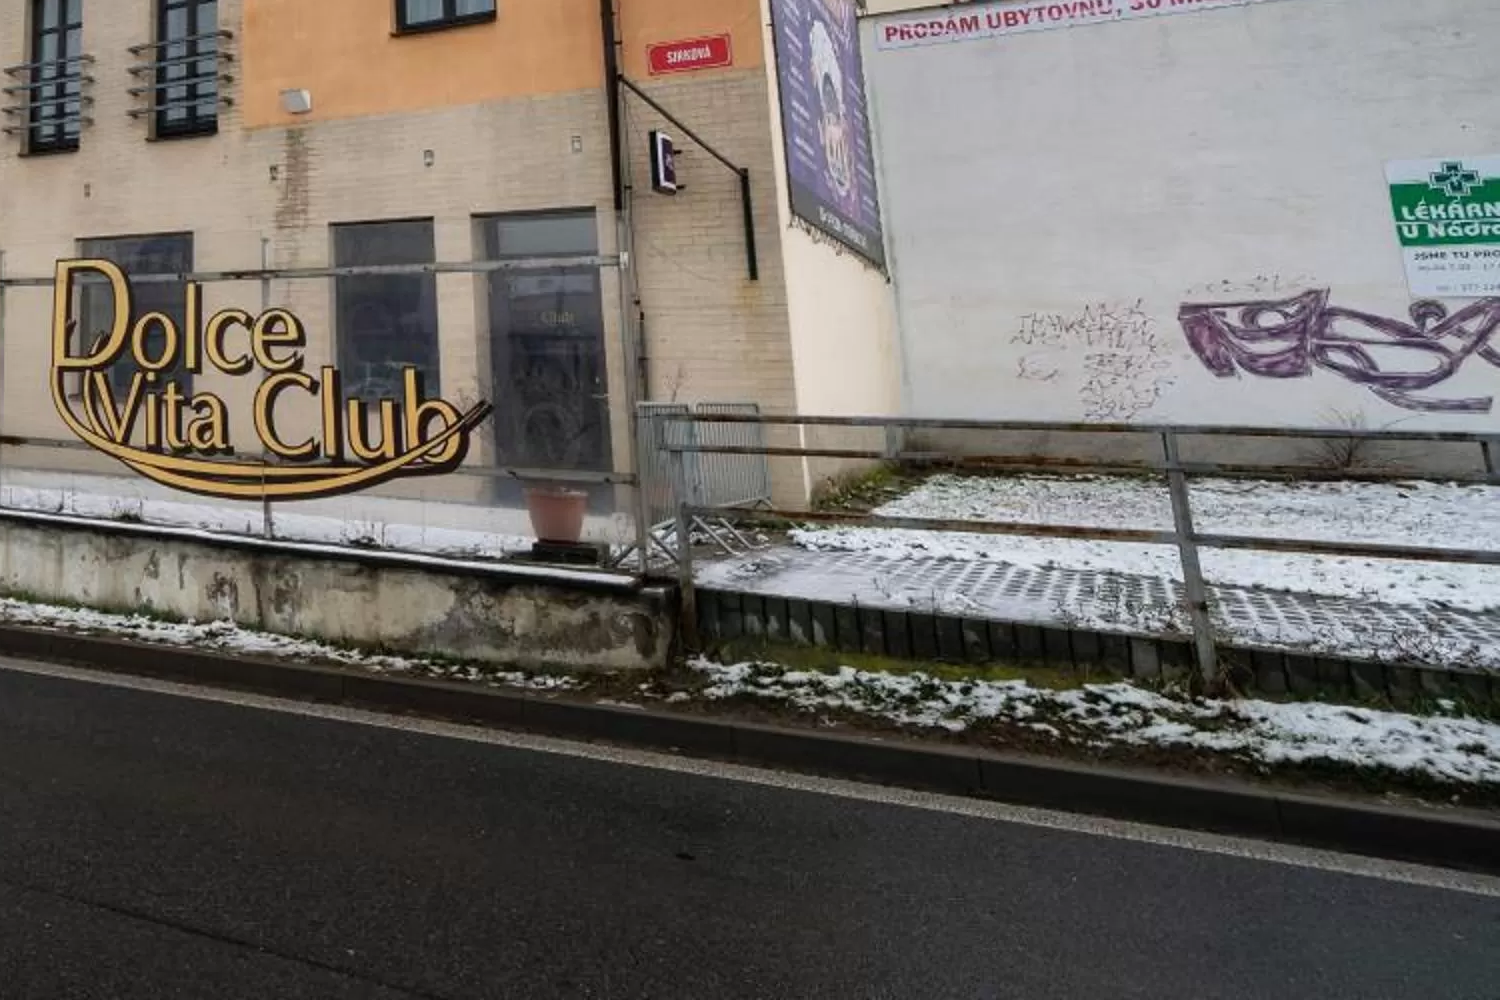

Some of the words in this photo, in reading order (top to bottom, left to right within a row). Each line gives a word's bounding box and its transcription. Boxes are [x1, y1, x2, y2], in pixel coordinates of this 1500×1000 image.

[885, 14, 980, 42] PRODÁM
[1401, 224, 1419, 238] U
[1452, 250, 1469, 259] TU
[52, 257, 306, 374] Dolce
[90, 369, 233, 457] Vita
[252, 364, 472, 477] Club
